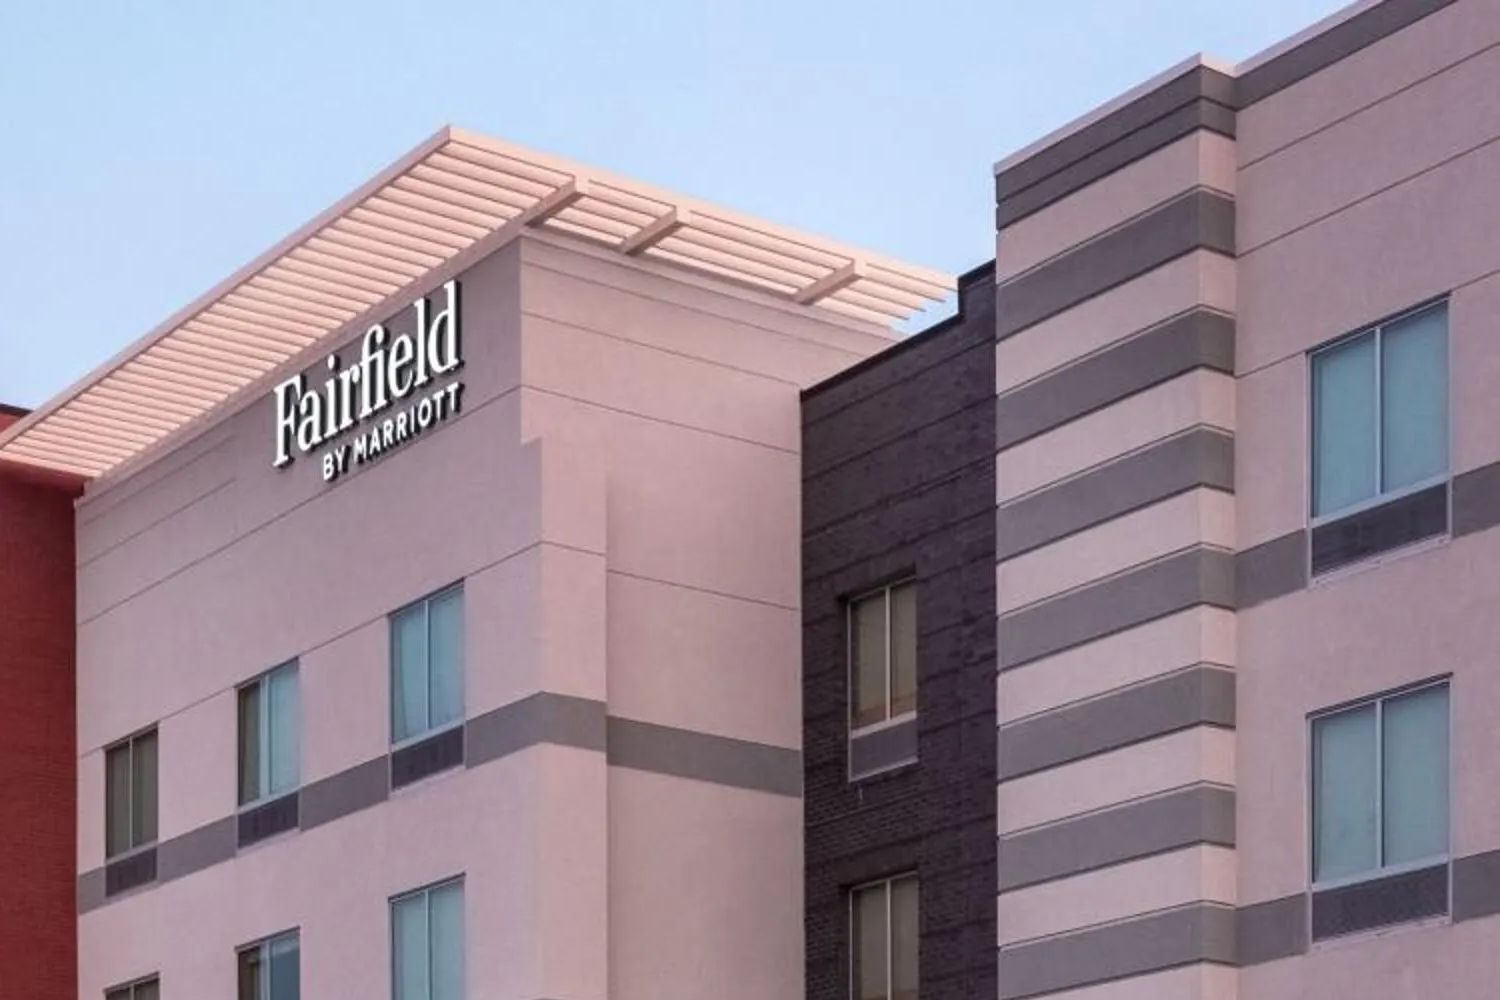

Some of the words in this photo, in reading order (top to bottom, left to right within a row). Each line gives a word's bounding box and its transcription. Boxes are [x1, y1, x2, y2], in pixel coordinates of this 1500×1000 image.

[273, 279, 460, 467] Fairfield
[323, 444, 347, 481] BY
[353, 381, 461, 462] MARRIOTT
